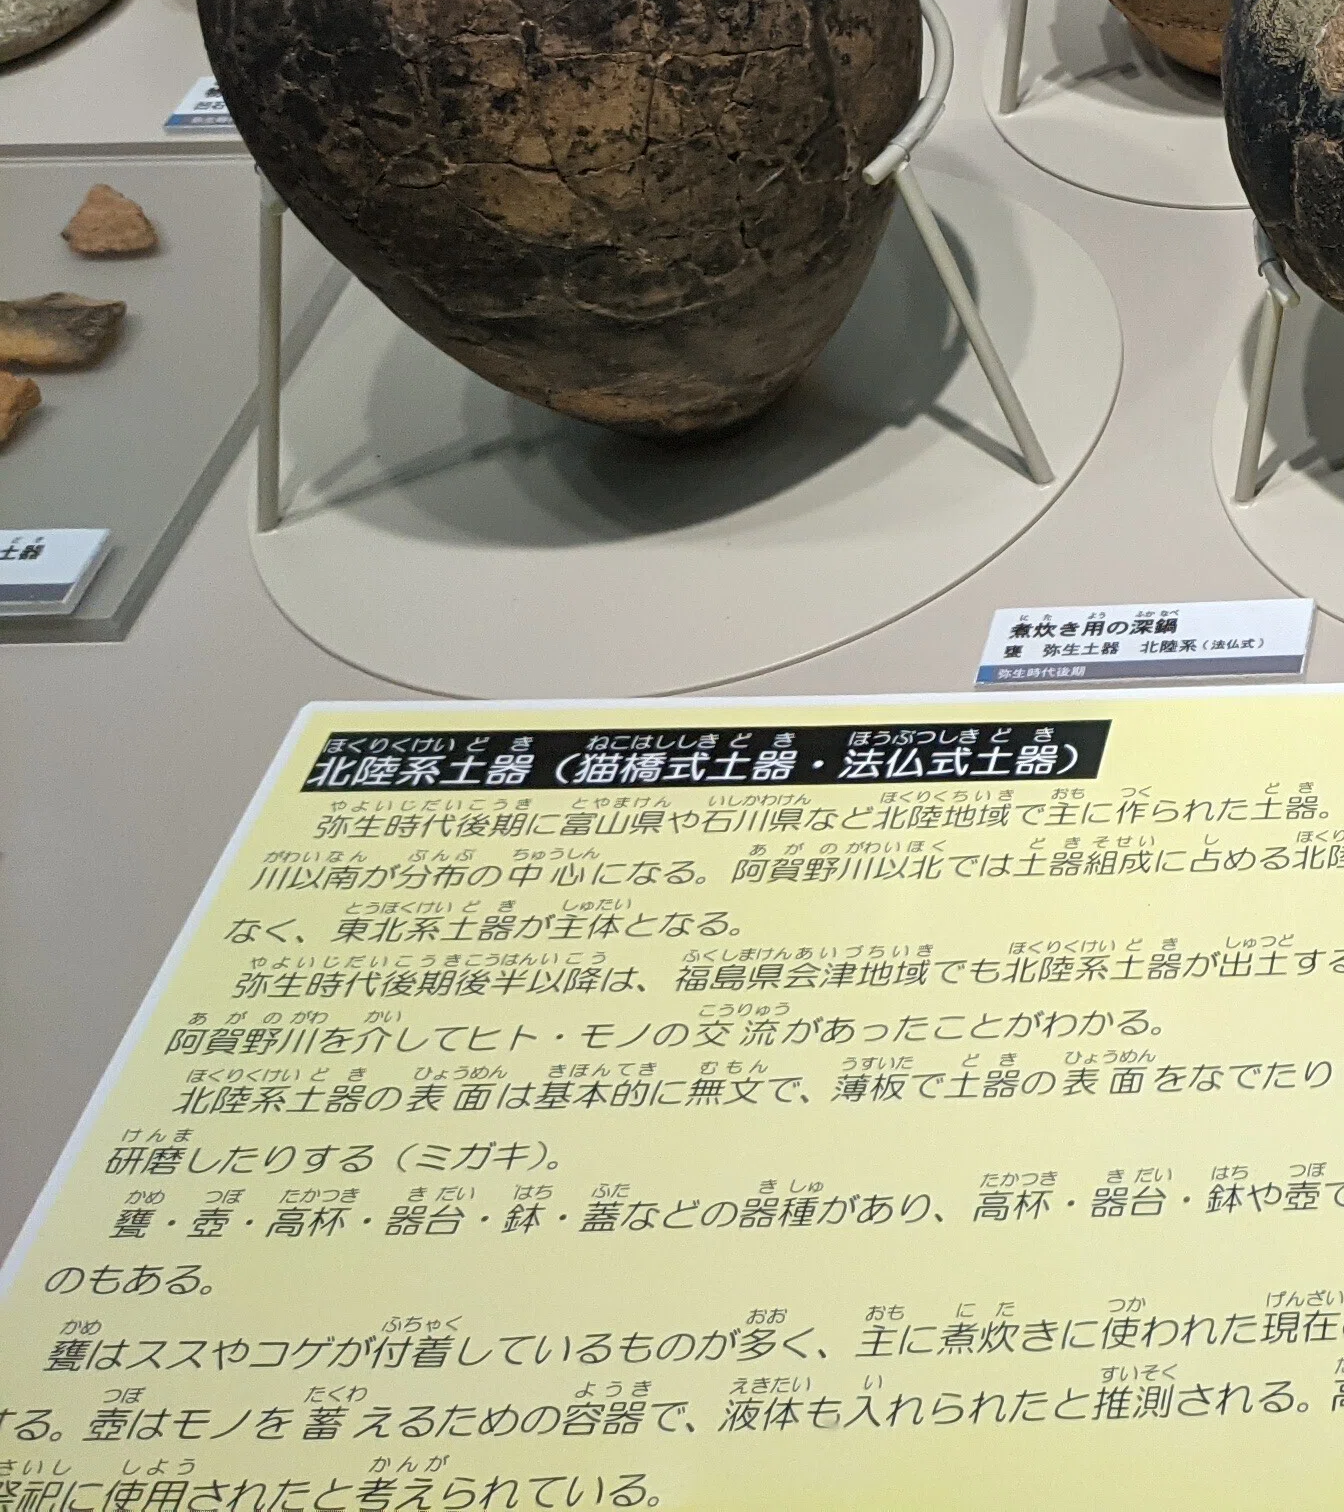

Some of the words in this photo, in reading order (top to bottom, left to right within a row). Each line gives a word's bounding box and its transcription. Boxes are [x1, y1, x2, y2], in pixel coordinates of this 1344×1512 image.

[1008, 618, 1179, 639] 煮炊き用の深鍋
[1042, 641, 1120, 658] 弥生土器
[224, 912, 740, 943] なく、東北系土器が主体となる。
[45, 1265, 212, 1295] のもある。
